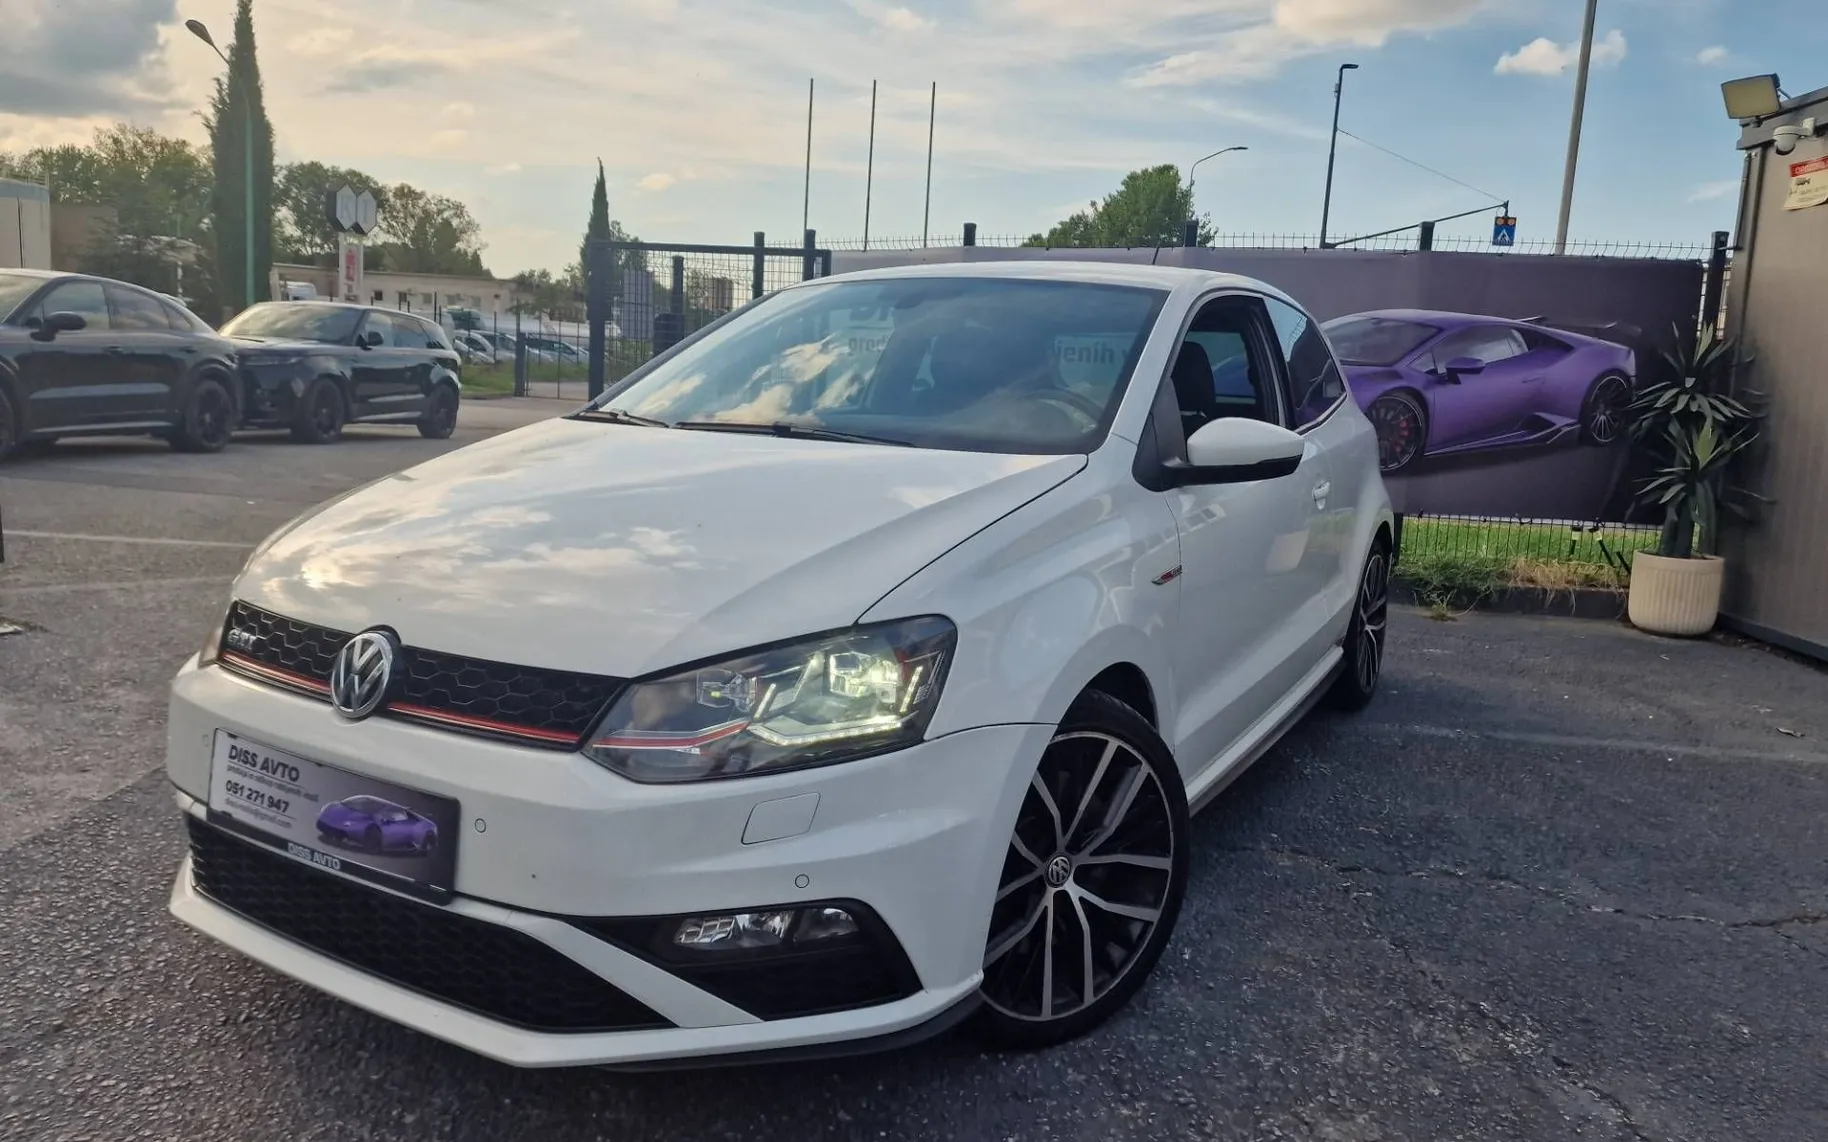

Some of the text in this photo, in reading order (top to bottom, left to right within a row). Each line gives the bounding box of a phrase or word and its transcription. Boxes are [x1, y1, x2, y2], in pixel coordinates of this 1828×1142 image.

[228, 744, 300, 782] DISS AVTO
[225, 779, 245, 797] 051
[246, 787, 265, 805] 271
[267, 795, 290, 813] 947
[287, 841, 341, 870] DISS AVTO
